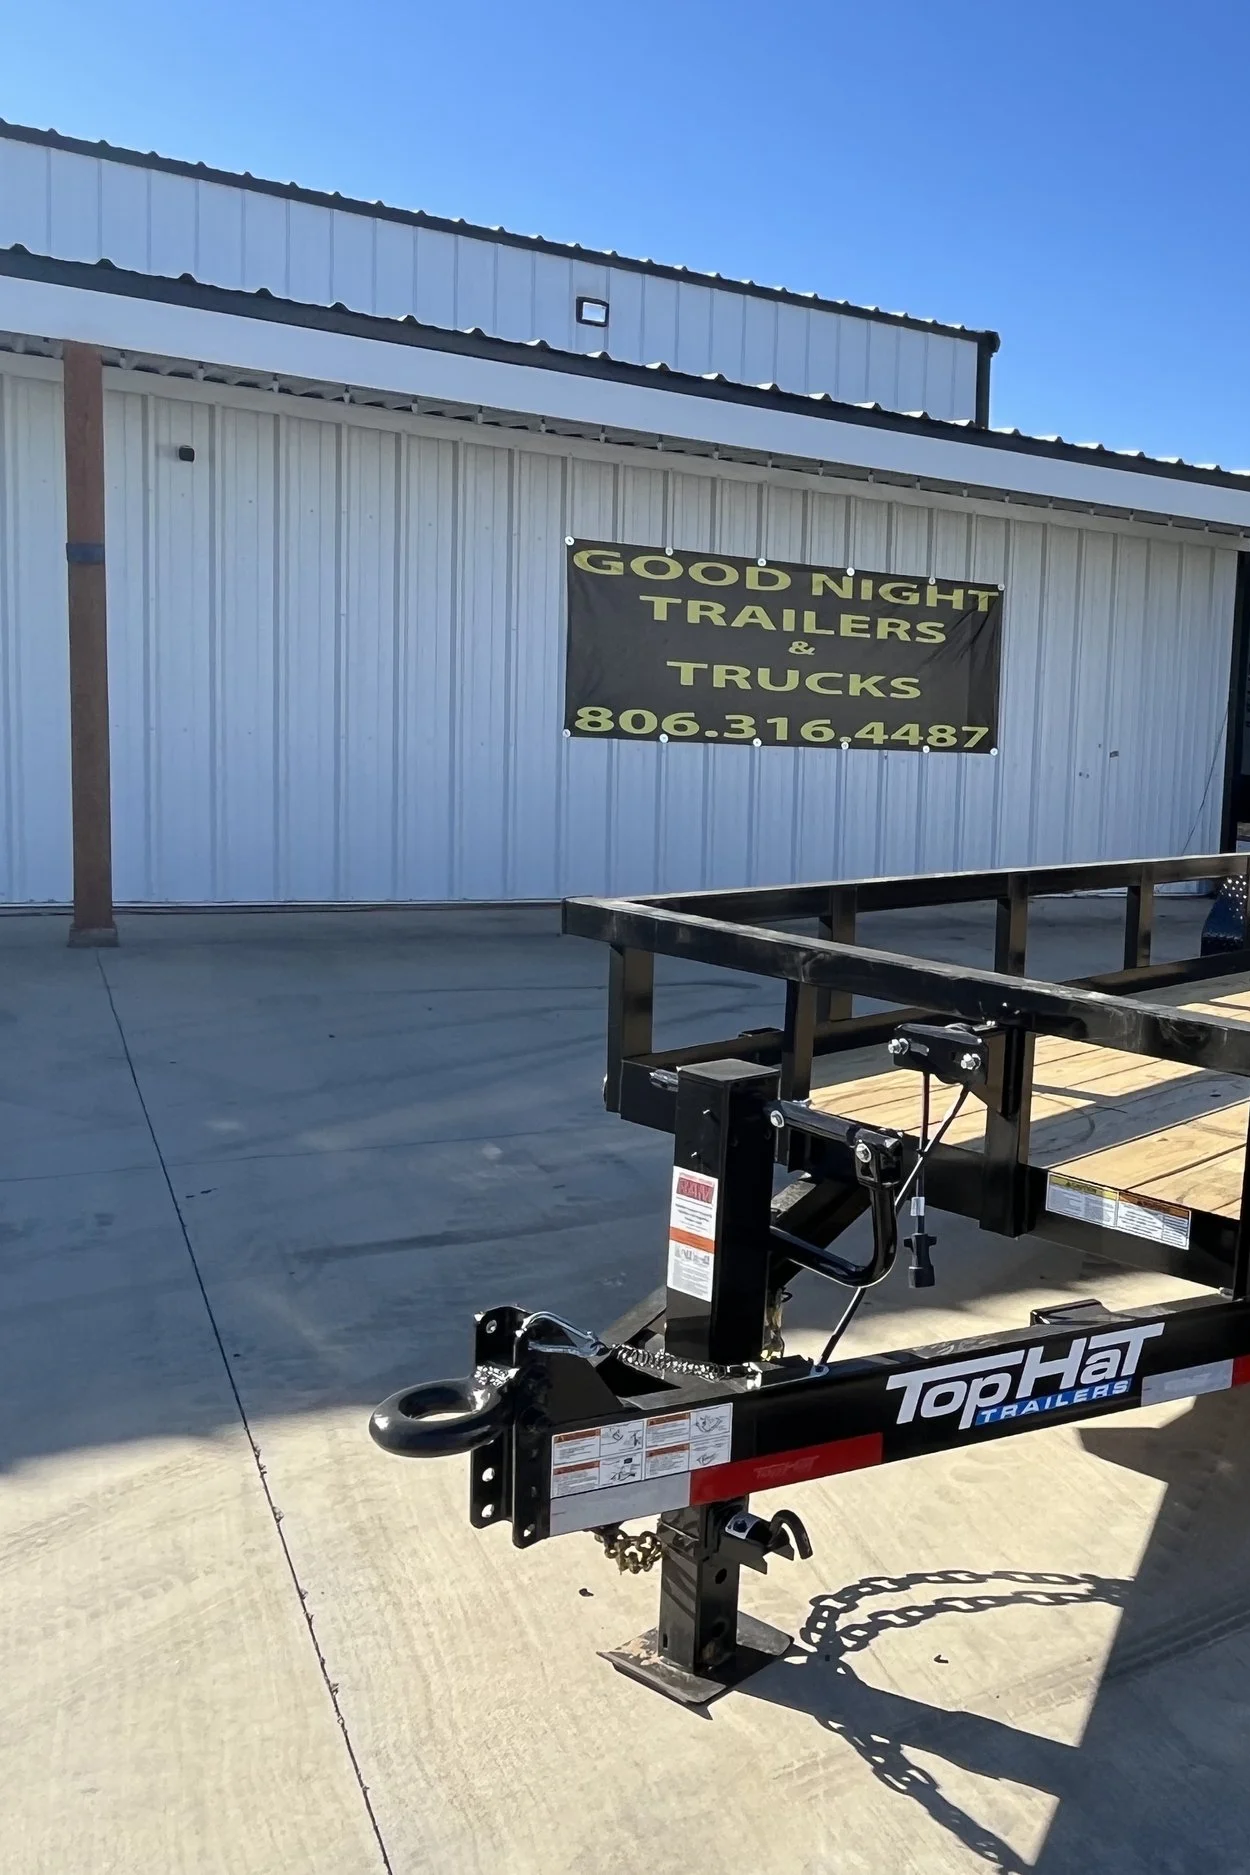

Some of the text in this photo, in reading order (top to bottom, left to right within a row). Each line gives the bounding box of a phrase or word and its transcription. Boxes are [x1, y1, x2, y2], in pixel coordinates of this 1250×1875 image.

[573, 550, 998, 612] GOOD NIGHT
[639, 595, 947, 644] TRAILERS
[788, 641, 816, 656] &
[666, 661, 921, 699] TRUCKS
[574, 706, 989, 749] 806.316.4487
[981, 1380, 1129, 1422] TRAILERS
